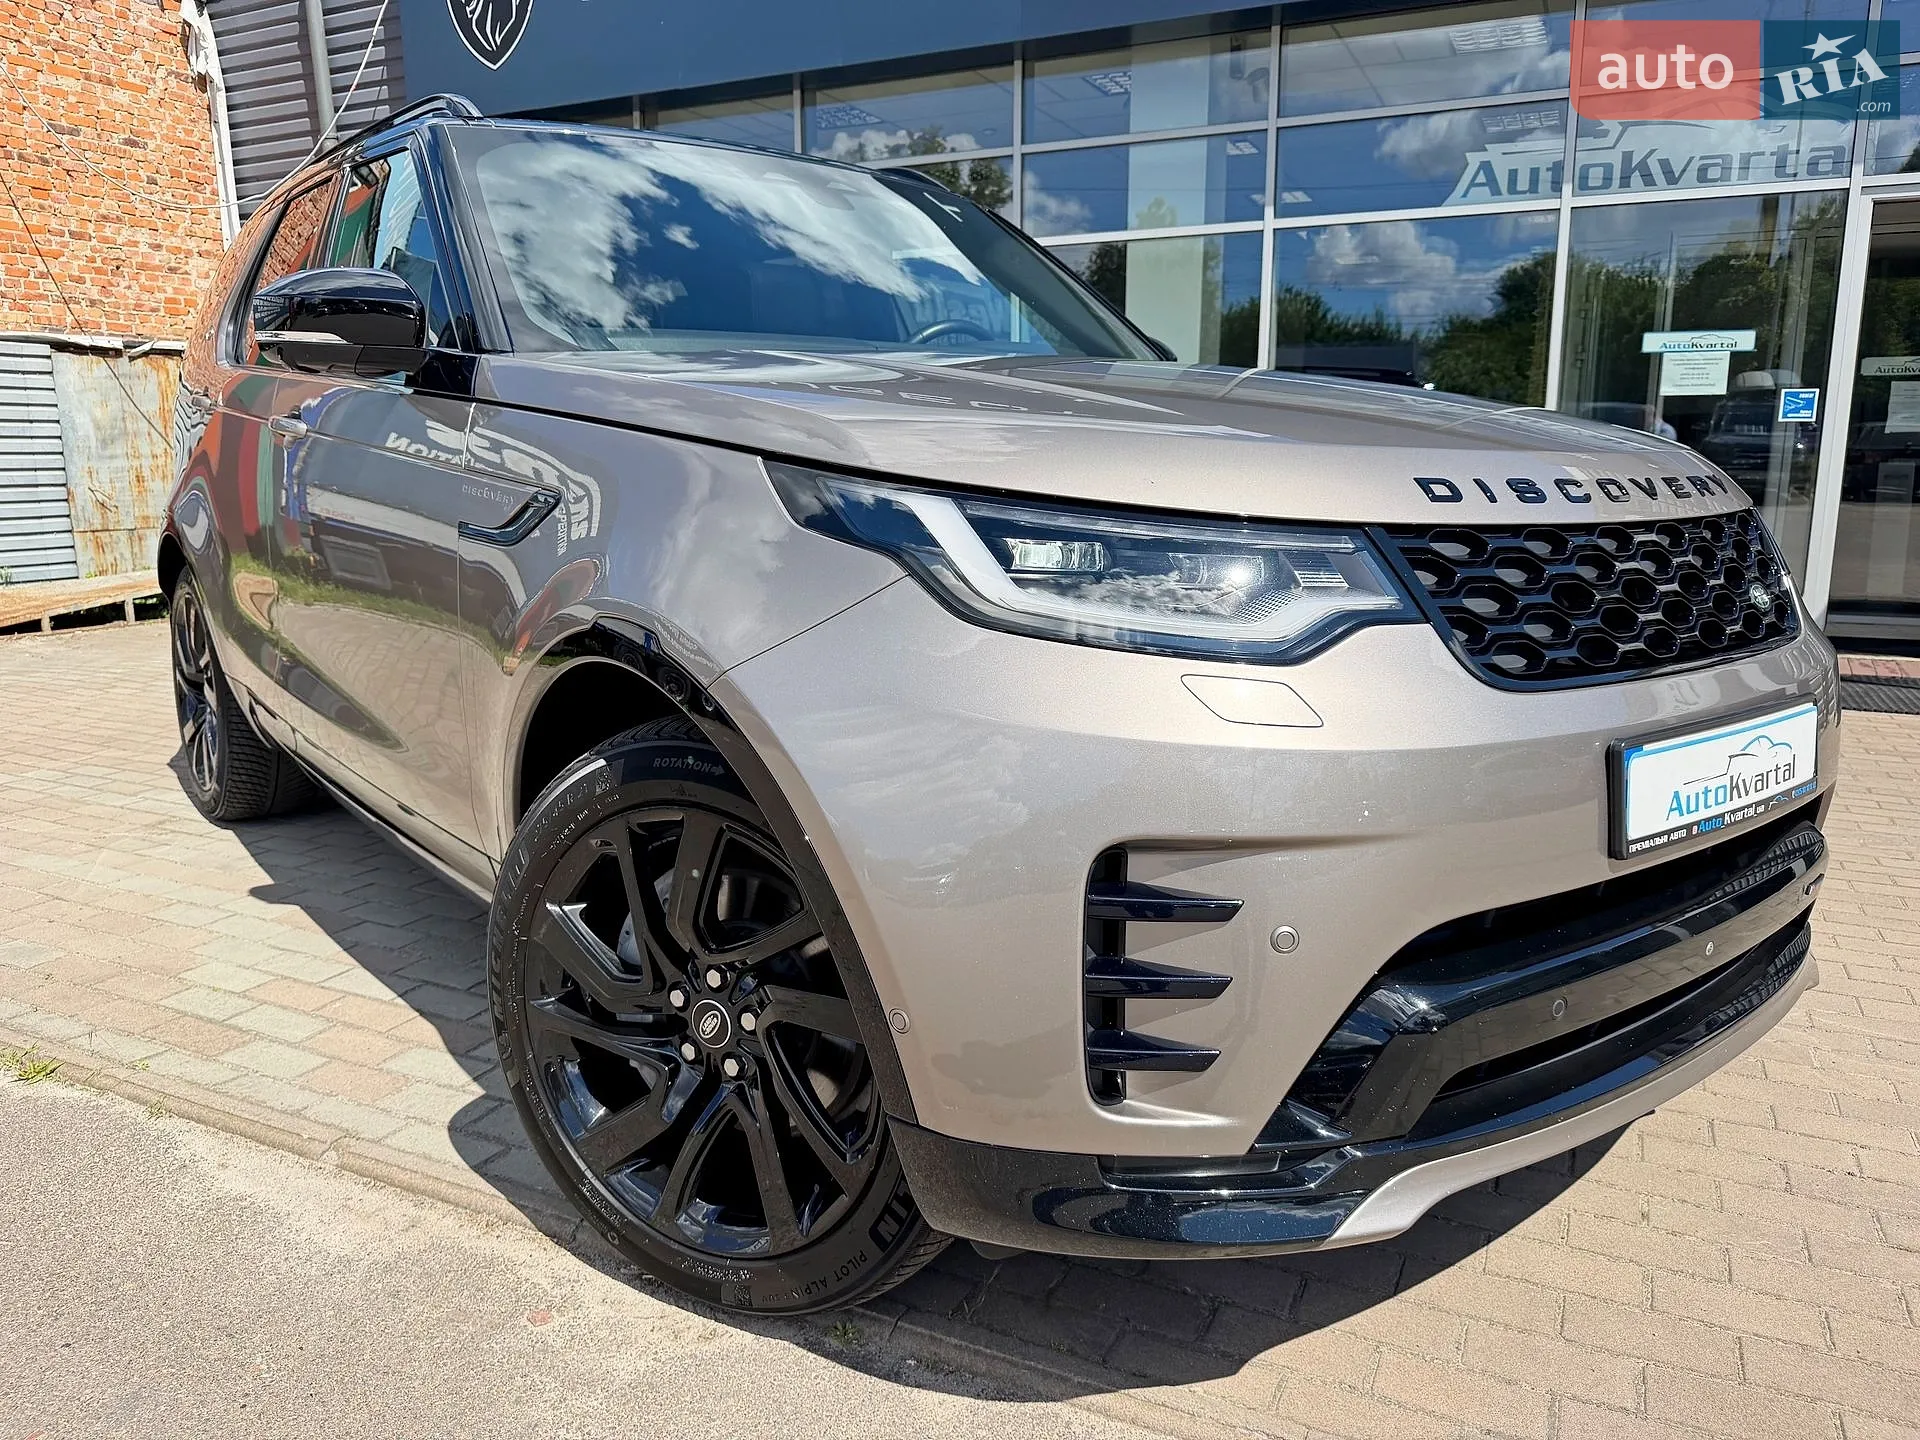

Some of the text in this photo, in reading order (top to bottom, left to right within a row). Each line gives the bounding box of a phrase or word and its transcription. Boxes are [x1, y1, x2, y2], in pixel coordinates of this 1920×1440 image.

[1461, 144, 1848, 199] AutoKvarta
[1660, 341, 1737, 349] AutoKvartal
[1413, 474, 1728, 503] DISCOVERY
[653, 757, 711, 773] ROTATION
[1666, 754, 1796, 821] AutoKvartal
[834, 1250, 868, 1282] PILOT
